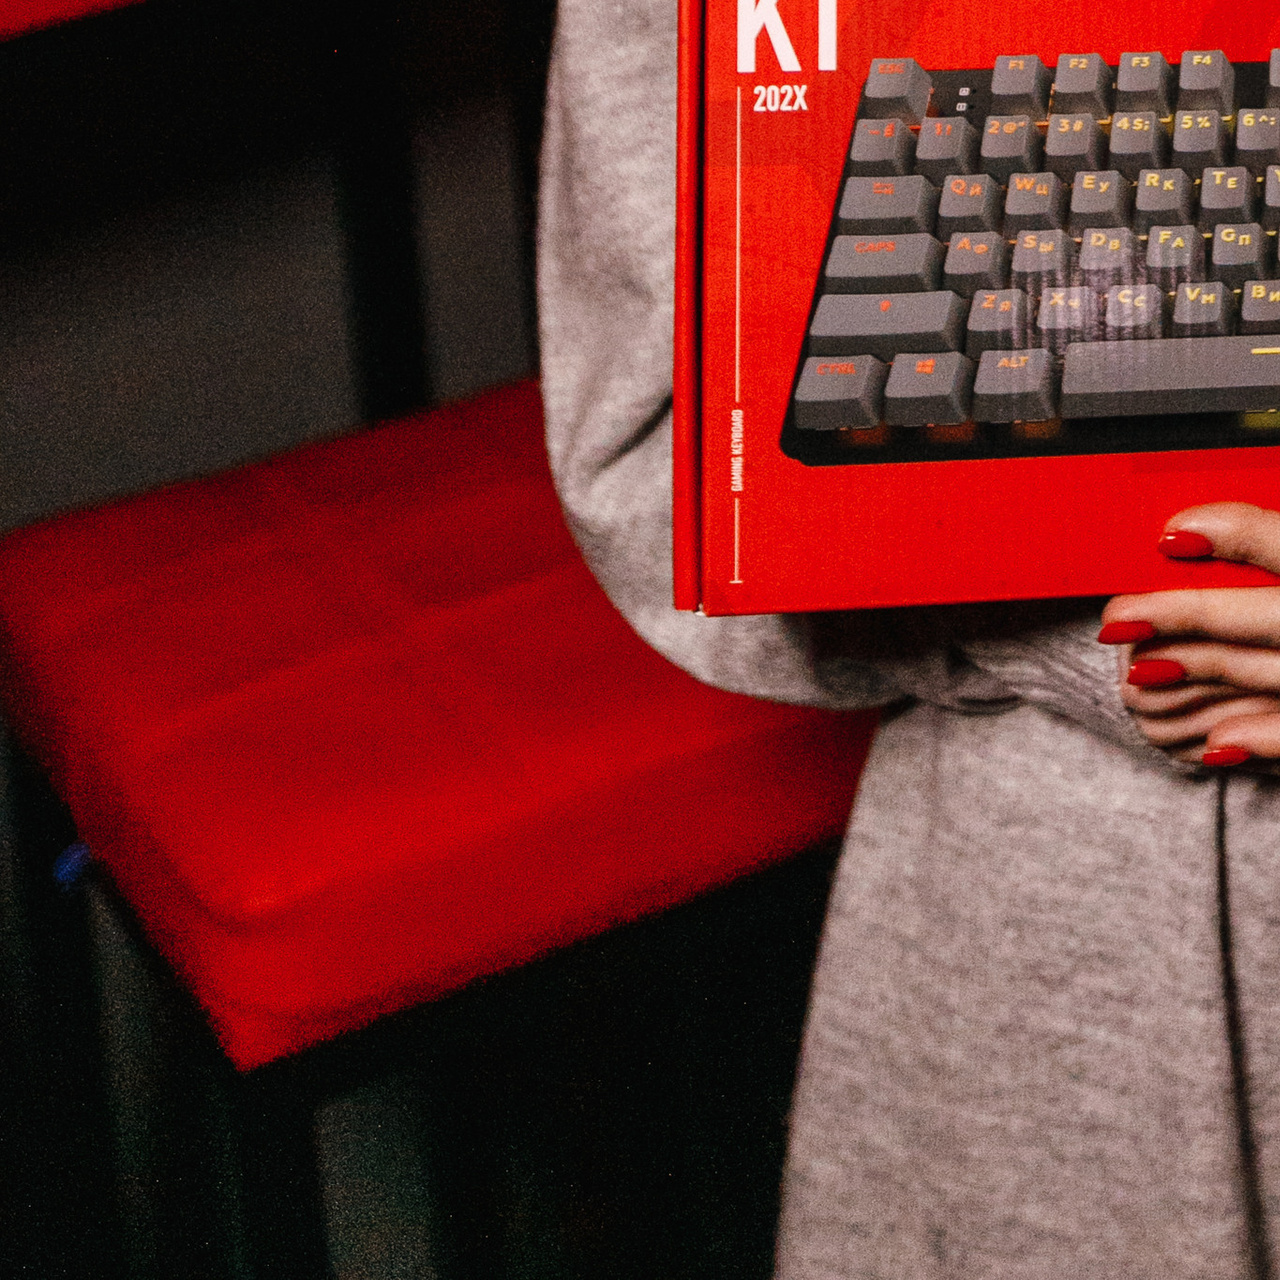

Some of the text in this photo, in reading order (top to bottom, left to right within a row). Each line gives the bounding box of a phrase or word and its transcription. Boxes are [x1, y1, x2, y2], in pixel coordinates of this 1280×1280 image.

[1069, 58, 1089, 70] F2
[1132, 56, 1150, 68] F3
[1193, 55, 1213, 66] F4
[753, 84, 808, 112] 202X
[854, 241, 896, 254] CAPS
[816, 362, 858, 376] CTRL
[997, 355, 1030, 369] ALT
[731, 409, 744, 455] KEYBOARD
